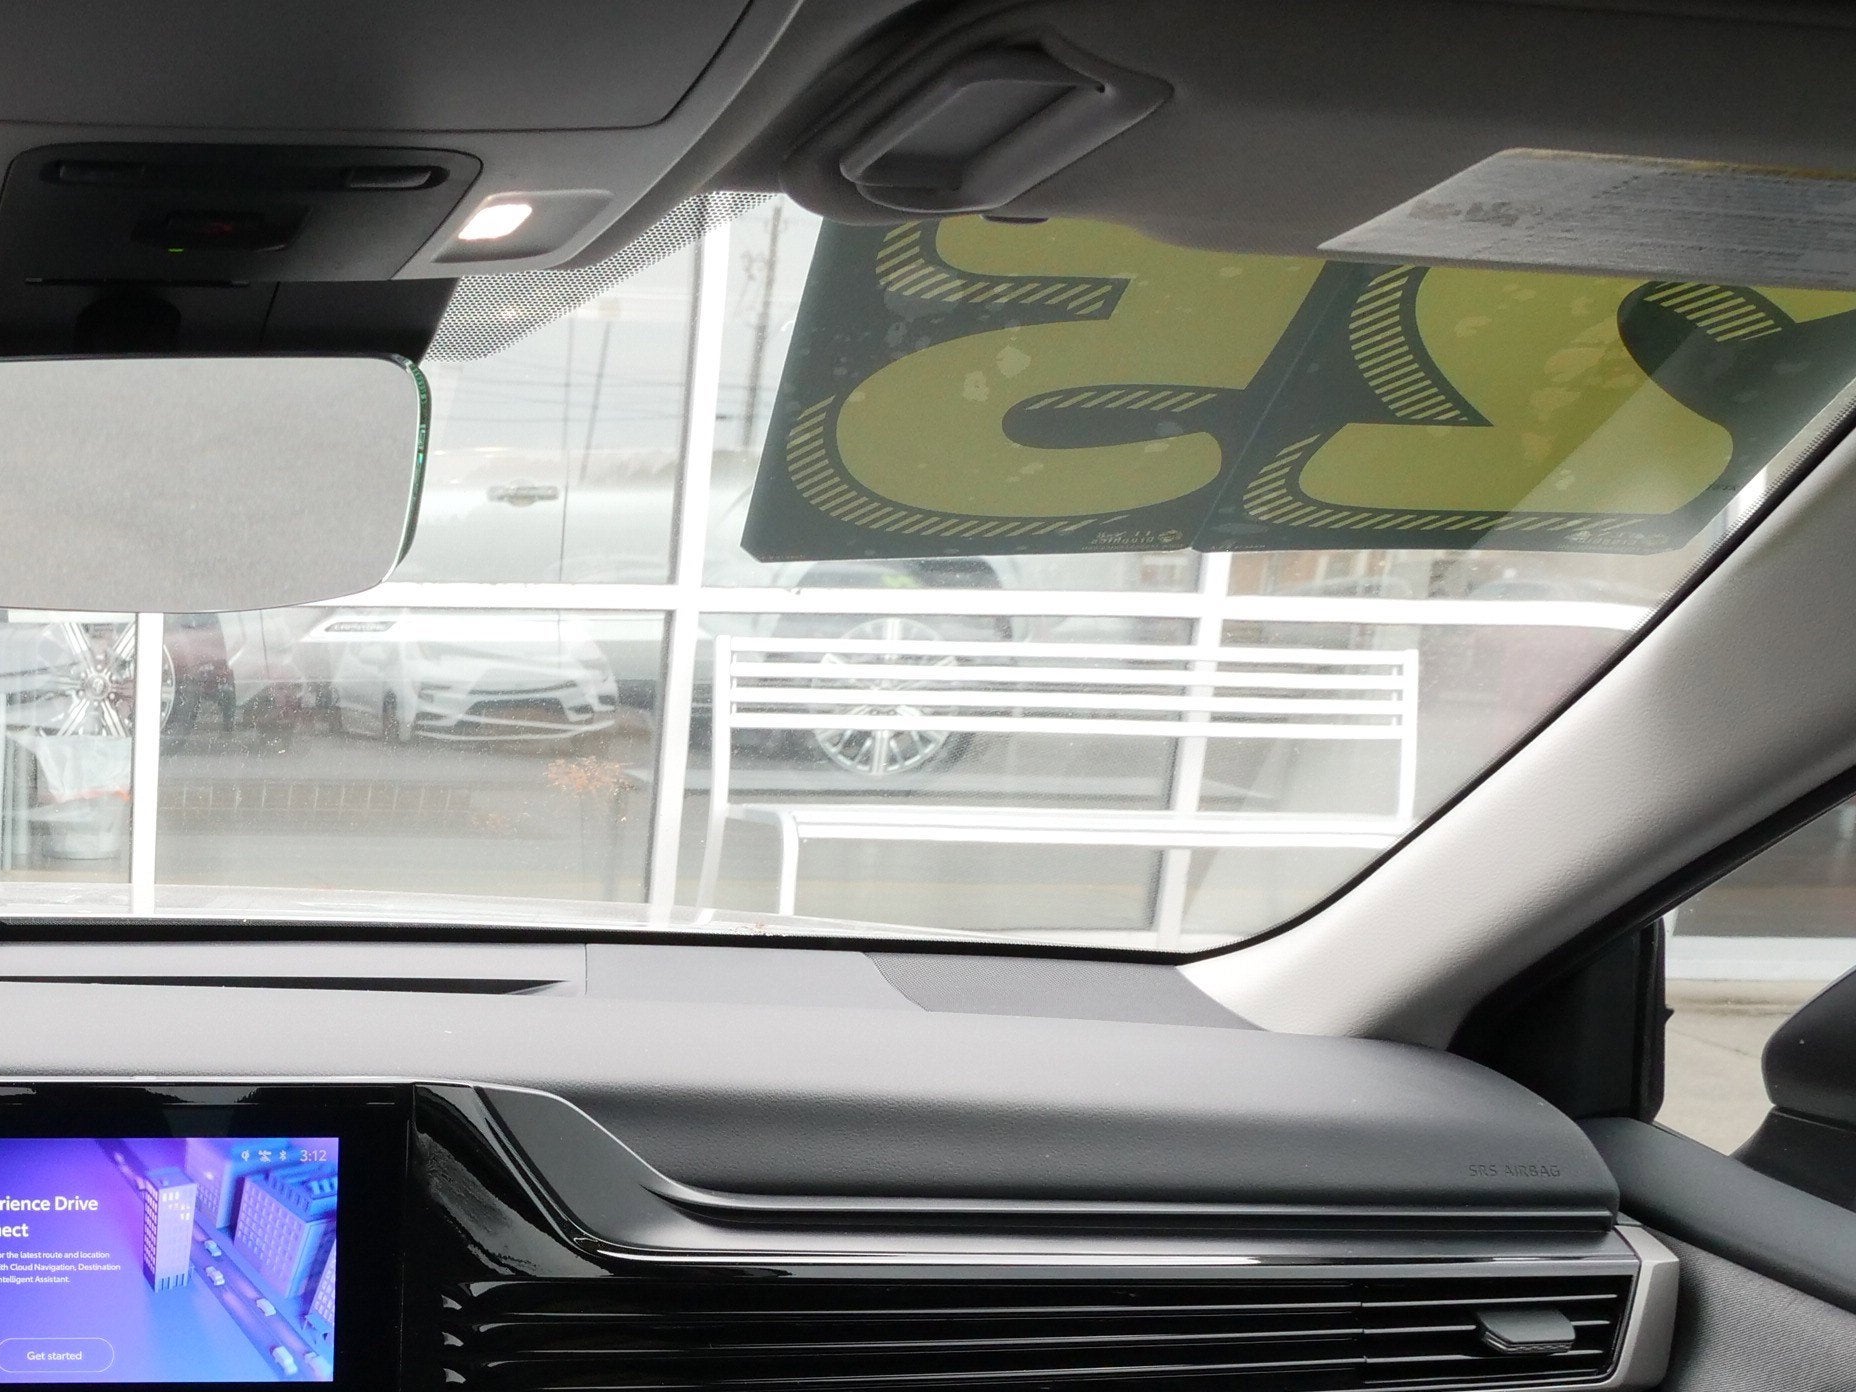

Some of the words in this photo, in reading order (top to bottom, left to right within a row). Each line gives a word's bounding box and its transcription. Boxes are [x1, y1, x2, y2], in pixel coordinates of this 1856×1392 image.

[299, 1149, 328, 1162] 3:12
[1468, 1164, 1497, 1177] SRS
[1504, 1164, 1561, 1178] AIRBAG
[54, 1195, 99, 1211] Drive
[6, 1251, 19, 1259] the
[20, 1251, 42, 1259] latest
[64, 1251, 79, 1259] and
[80, 1251, 110, 1259] location
[34, 1264, 77, 1273] Navigation,
[35, 1276, 70, 1284] Assistant.
[26, 1350, 45, 1361] Get
[48, 1350, 83, 1361] started
